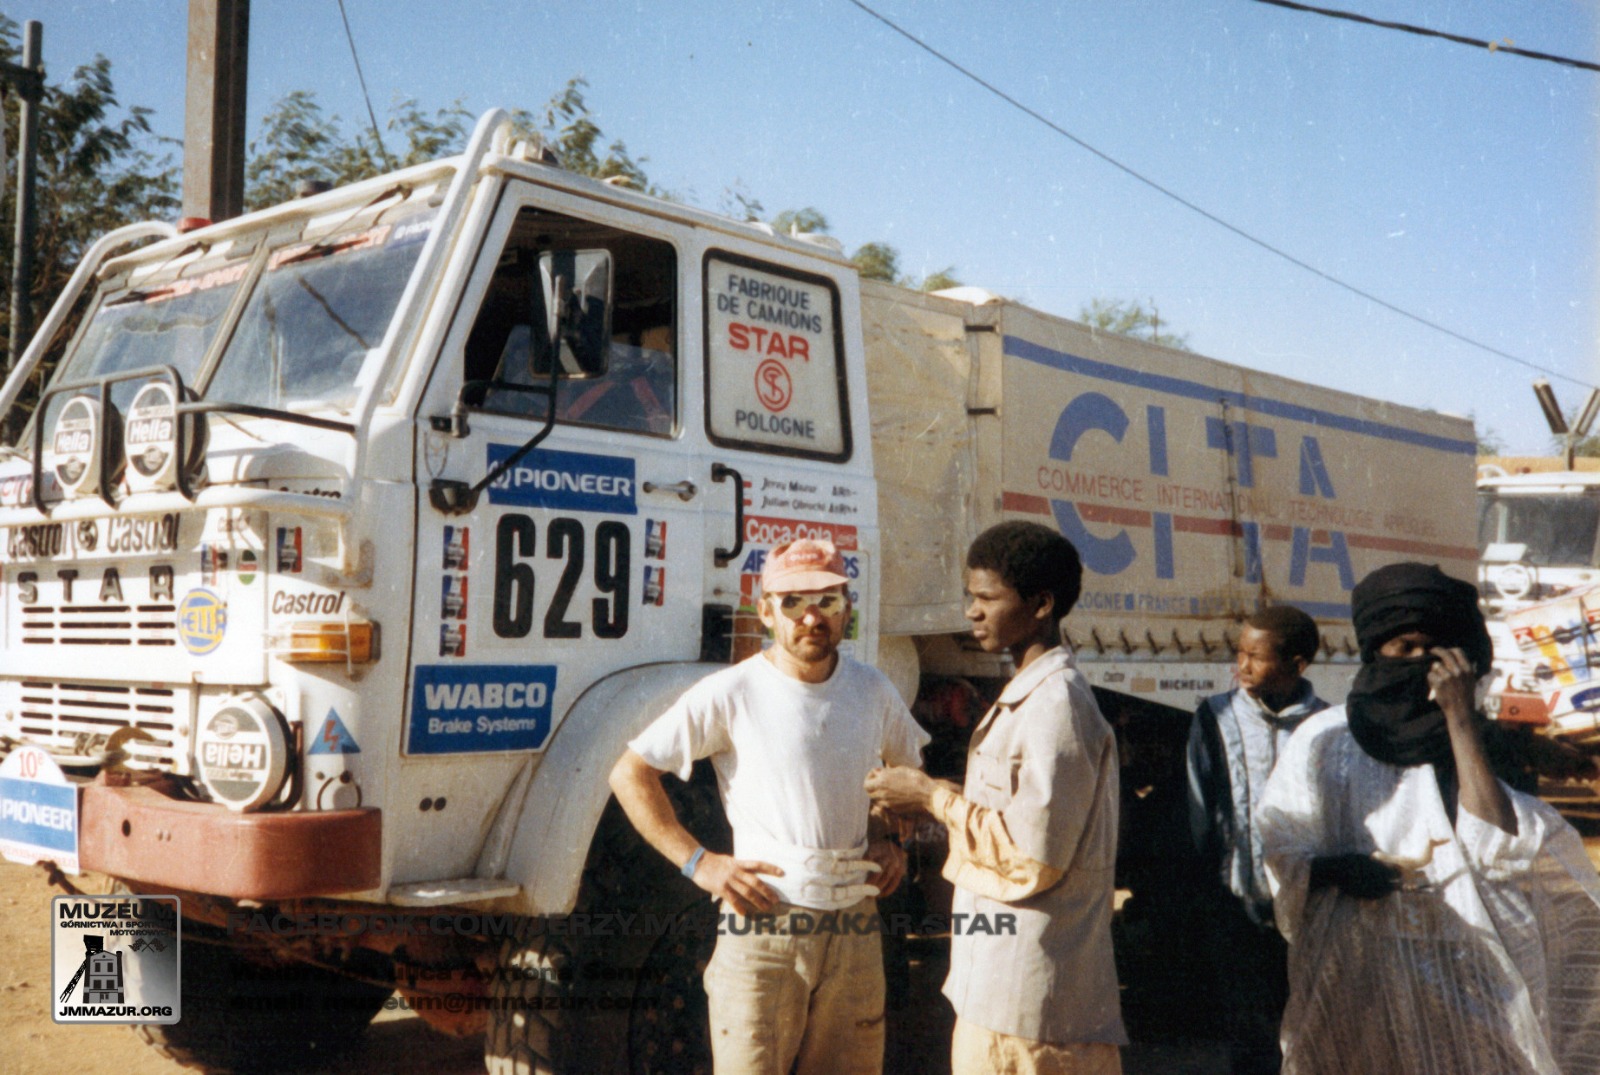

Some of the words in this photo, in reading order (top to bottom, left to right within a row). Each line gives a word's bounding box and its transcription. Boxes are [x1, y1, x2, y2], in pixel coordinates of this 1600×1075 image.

[728, 274, 810, 311] FABRIQUE
[717, 293, 740, 315] DE
[747, 301, 822, 334] CAMIONS
[728, 322, 810, 363] STAR
[130, 418, 172, 443] Hella
[735, 409, 815, 439] POLOGNE
[514, 467, 632, 498] PIONEER
[1037, 465, 1144, 503] COMMERCE
[1049, 391, 1357, 591] CITA
[746, 518, 832, 545] Coca-Cola
[17, 564, 175, 604] STAR
[492, 513, 631, 639] 629
[272, 590, 346, 615] Castrol
[424, 682, 548, 710] WABCO
[1159, 679, 1215, 691] MICHELIN
[428, 717, 473, 734] Brake
[476, 715, 536, 736] Systems
[205, 743, 262, 769] Hella
[1, 798, 73, 832] PIONEER
